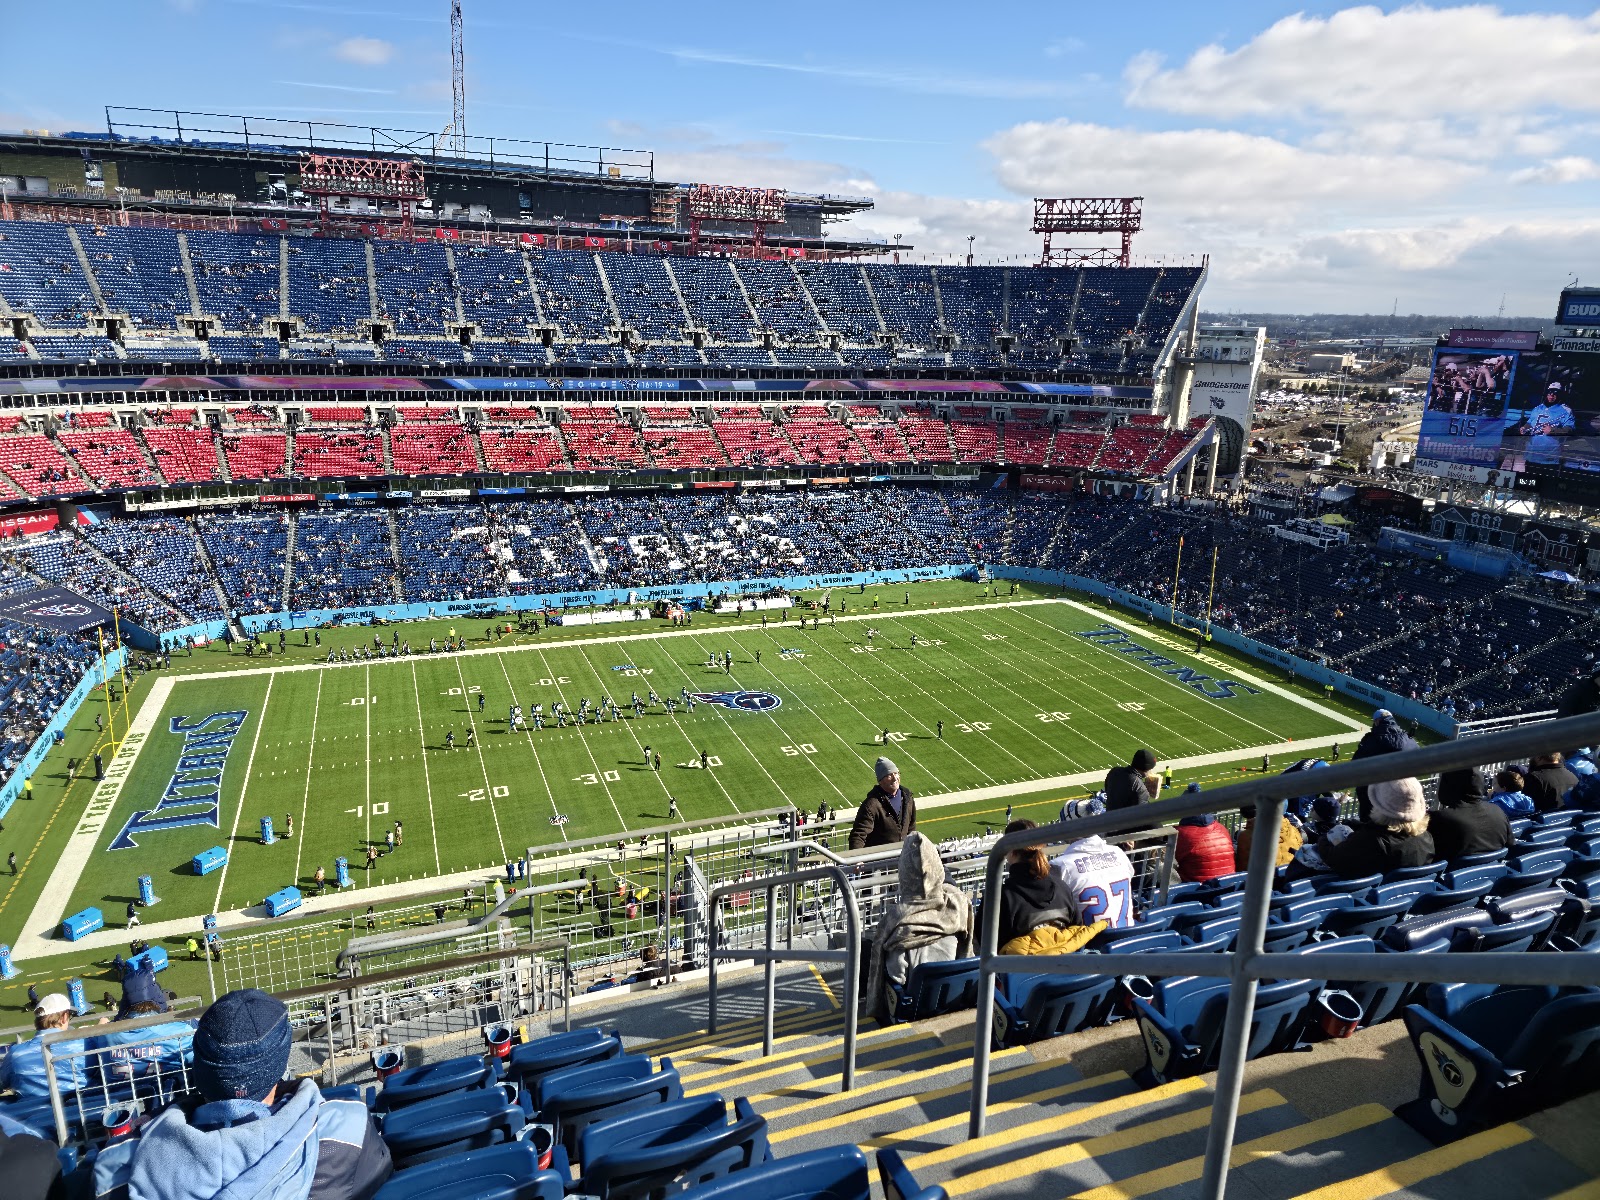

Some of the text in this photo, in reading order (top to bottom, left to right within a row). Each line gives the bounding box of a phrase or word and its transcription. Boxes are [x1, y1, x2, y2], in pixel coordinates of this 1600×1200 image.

[1553, 338, 1600, 351] Pinnacle
[1193, 380, 1250, 390] BRIDGESTONE
[1450, 417, 1478, 437] 615
[1423, 436, 1496, 462] Trumpeters
[1416, 458, 1439, 469] MARS
[1026, 477, 1066, 486] NISSAN
[0, 514, 49, 528] ISSAN
[1071, 623, 1264, 700] TITANS
[539, 676, 572, 686] 30
[448, 685, 482, 695] 20
[350, 695, 377, 706] 10
[1035, 711, 1071, 722] 20
[955, 721, 992, 733] 30
[780, 743, 818, 756] 50
[688, 755, 723, 769] 40
[76, 732, 146, 835] IT TAKES ALL OF US
[106, 709, 249, 851] TITANS
[579, 769, 621, 786] 30
[468, 785, 510, 802] 20
[352, 801, 390, 818] 10
[1079, 878, 1130, 928] 27
[111, 1046, 162, 1058] MATTHEWS
[1438, 1106, 1449, 1117] P
